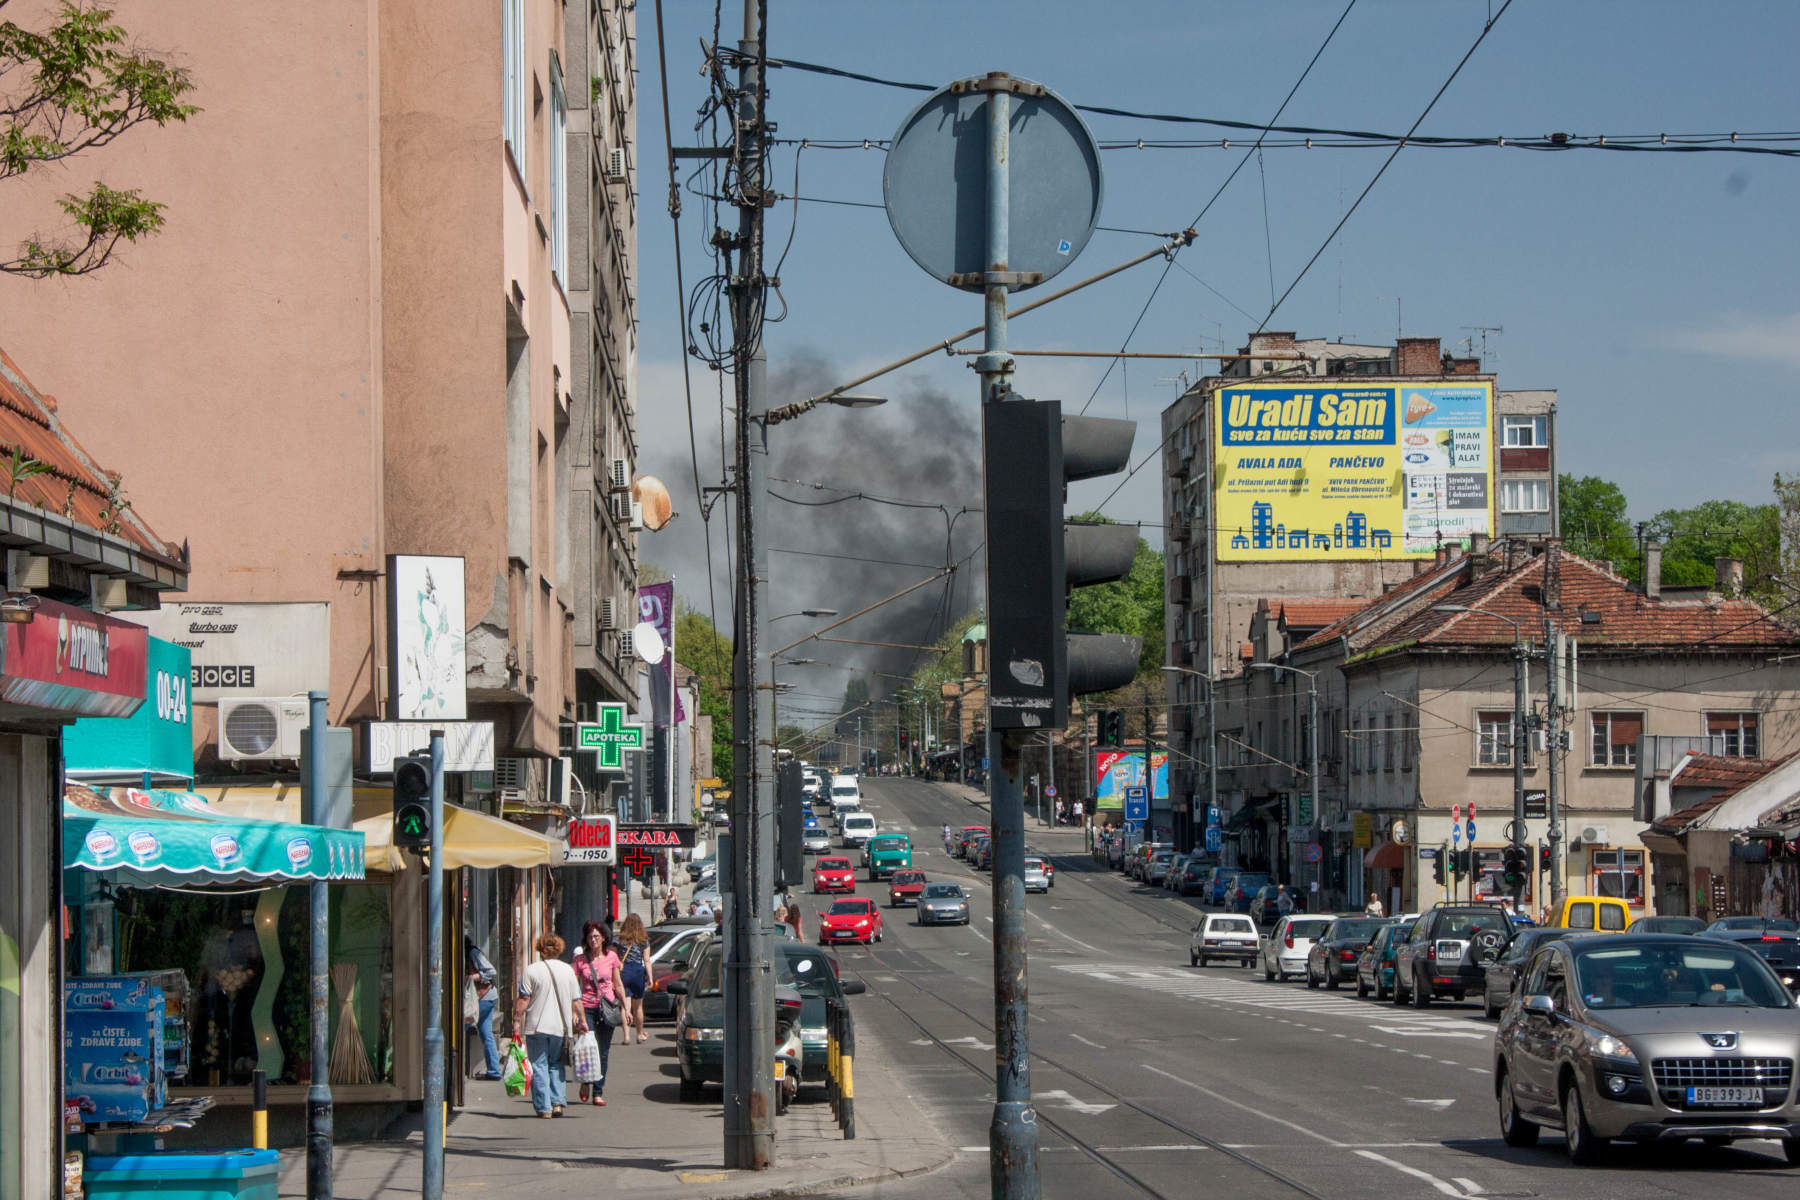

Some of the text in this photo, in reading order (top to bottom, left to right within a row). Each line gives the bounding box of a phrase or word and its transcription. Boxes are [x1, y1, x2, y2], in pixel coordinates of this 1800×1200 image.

[1228, 393, 1387, 427] Uradi Sam
[1229, 427, 1384, 441] sve za kuću sve za stan
[1455, 432, 1480, 440] IMAM
[1455, 443, 1480, 451] PRAVI
[1237, 457, 1303, 469] AVALA ADA
[1329, 455, 1385, 468] PANČEVO
[1458, 454, 1480, 462] ALAT
[181, 606, 223, 616] pro gas
[219, 623, 239, 632] gas
[192, 667, 253, 685] BOGE
[156, 668, 187, 725] 00-24
[586, 733, 636, 742] APOTEKA
[1099, 752, 1119, 772] NOVO
[569, 819, 611, 847] Odeća
[615, 830, 681, 845] EKARA
[102, 1025, 125, 1037] ČISTE
[80, 1037, 116, 1047] ZDRAVE
[117, 1037, 143, 1047] ZUBE
[94, 1065, 131, 1080] Orbit
[1696, 1088, 1712, 1101] BG
